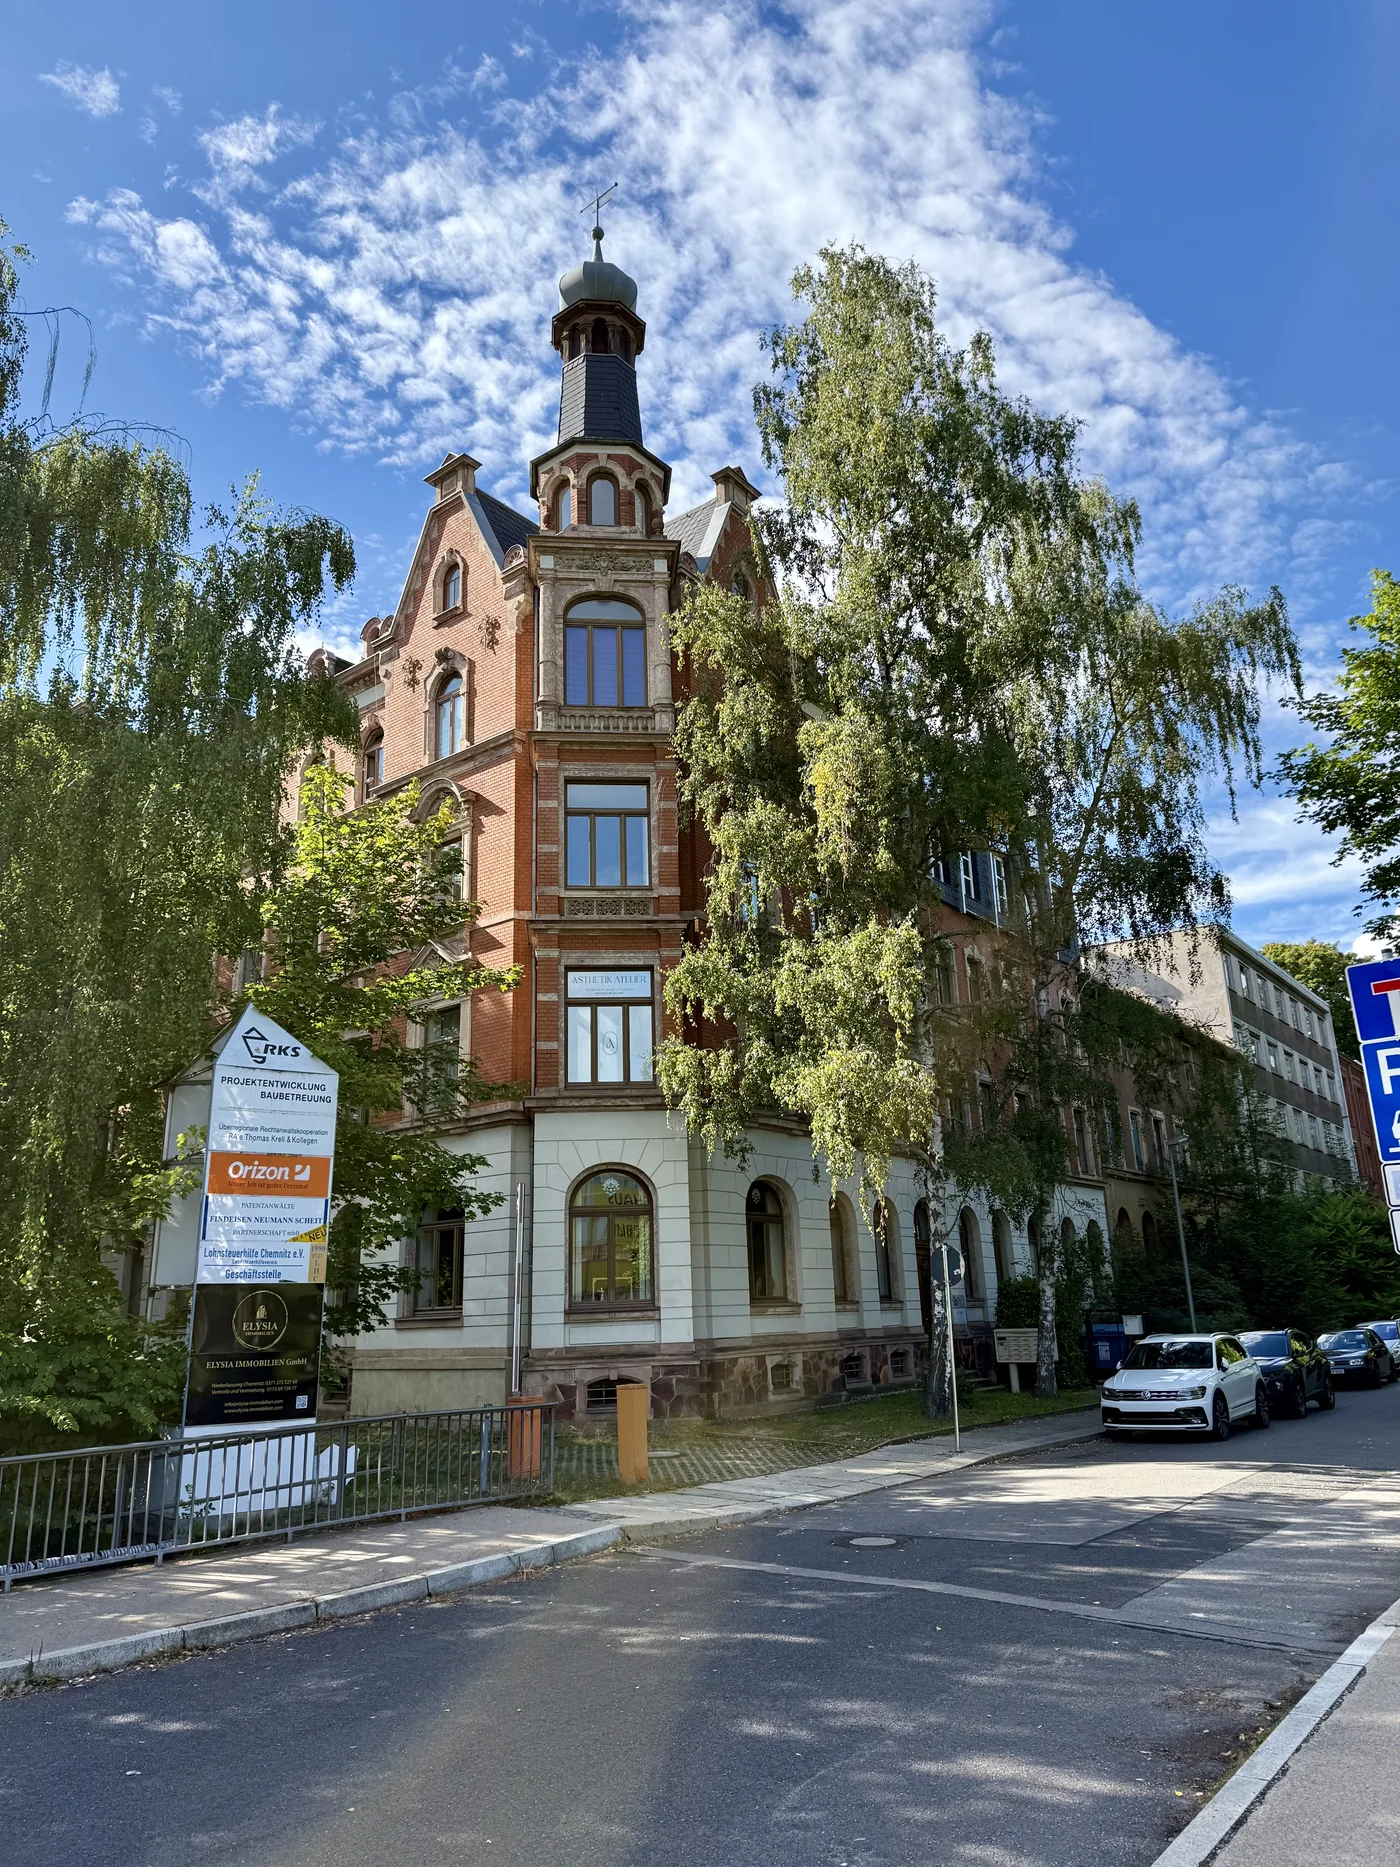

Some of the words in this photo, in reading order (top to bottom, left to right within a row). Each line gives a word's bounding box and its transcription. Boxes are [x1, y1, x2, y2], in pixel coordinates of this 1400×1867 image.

[221, 1076, 326, 1092] PROJEKTENTWICKLUNG
[260, 1091, 332, 1103] BAUBETREUUNG
[218, 1122, 259, 1133] Überregionale
[245, 1134, 269, 1142] Thomas
[271, 1135, 286, 1143] Krell
[291, 1136, 318, 1145] Kollegen
[228, 1160, 289, 1180] Orizon
[247, 1181, 257, 1189] Job
[266, 1182, 282, 1190] gutes
[283, 1182, 309, 1190] Personal
[210, 1215, 252, 1223] FINDEISEN
[254, 1216, 294, 1224] NEUMANN
[308, 1228, 327, 1242] NEU
[204, 1248, 259, 1259] Lohnsteuerhilfe
[260, 1248, 291, 1259] Chemnitz
[292, 1248, 305, 1259] e.V.
[225, 1268, 282, 1279] Geschäftsstelle
[242, 1322, 278, 1331] ELYSIA
[205, 1360, 234, 1369] ELYSIA
[235, 1359, 285, 1368] IMMOBILIEN
[286, 1357, 307, 1366] GmbH
